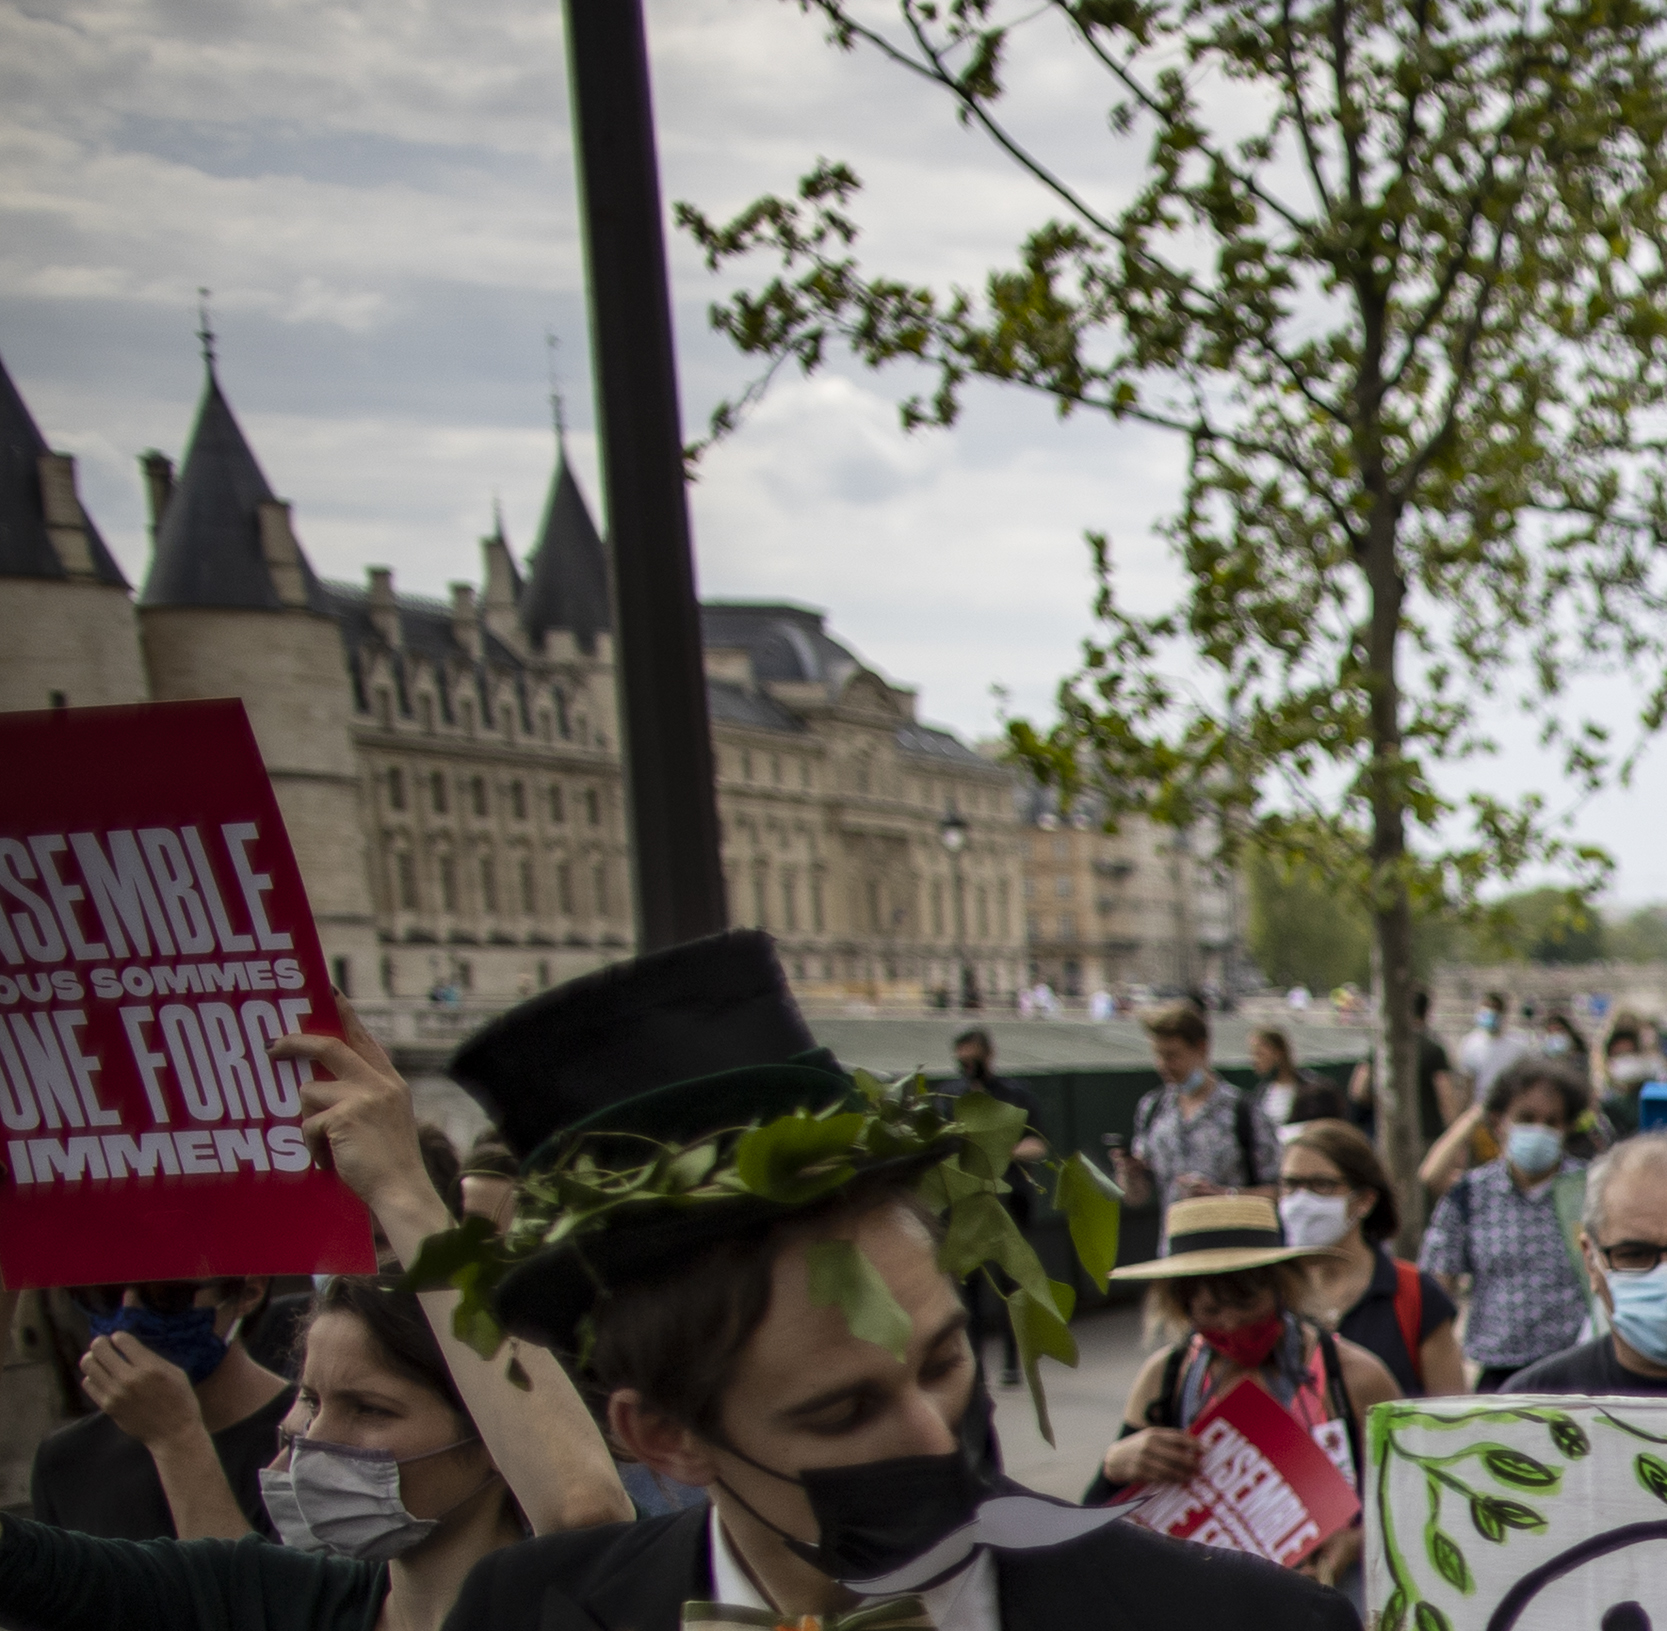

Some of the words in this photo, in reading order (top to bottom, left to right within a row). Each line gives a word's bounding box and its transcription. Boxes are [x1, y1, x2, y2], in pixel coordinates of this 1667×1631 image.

[0, 822, 294, 965] SEMBLE
[91, 959, 304, 999] SOMMES
[7, 1125, 321, 1184] IMMENS
